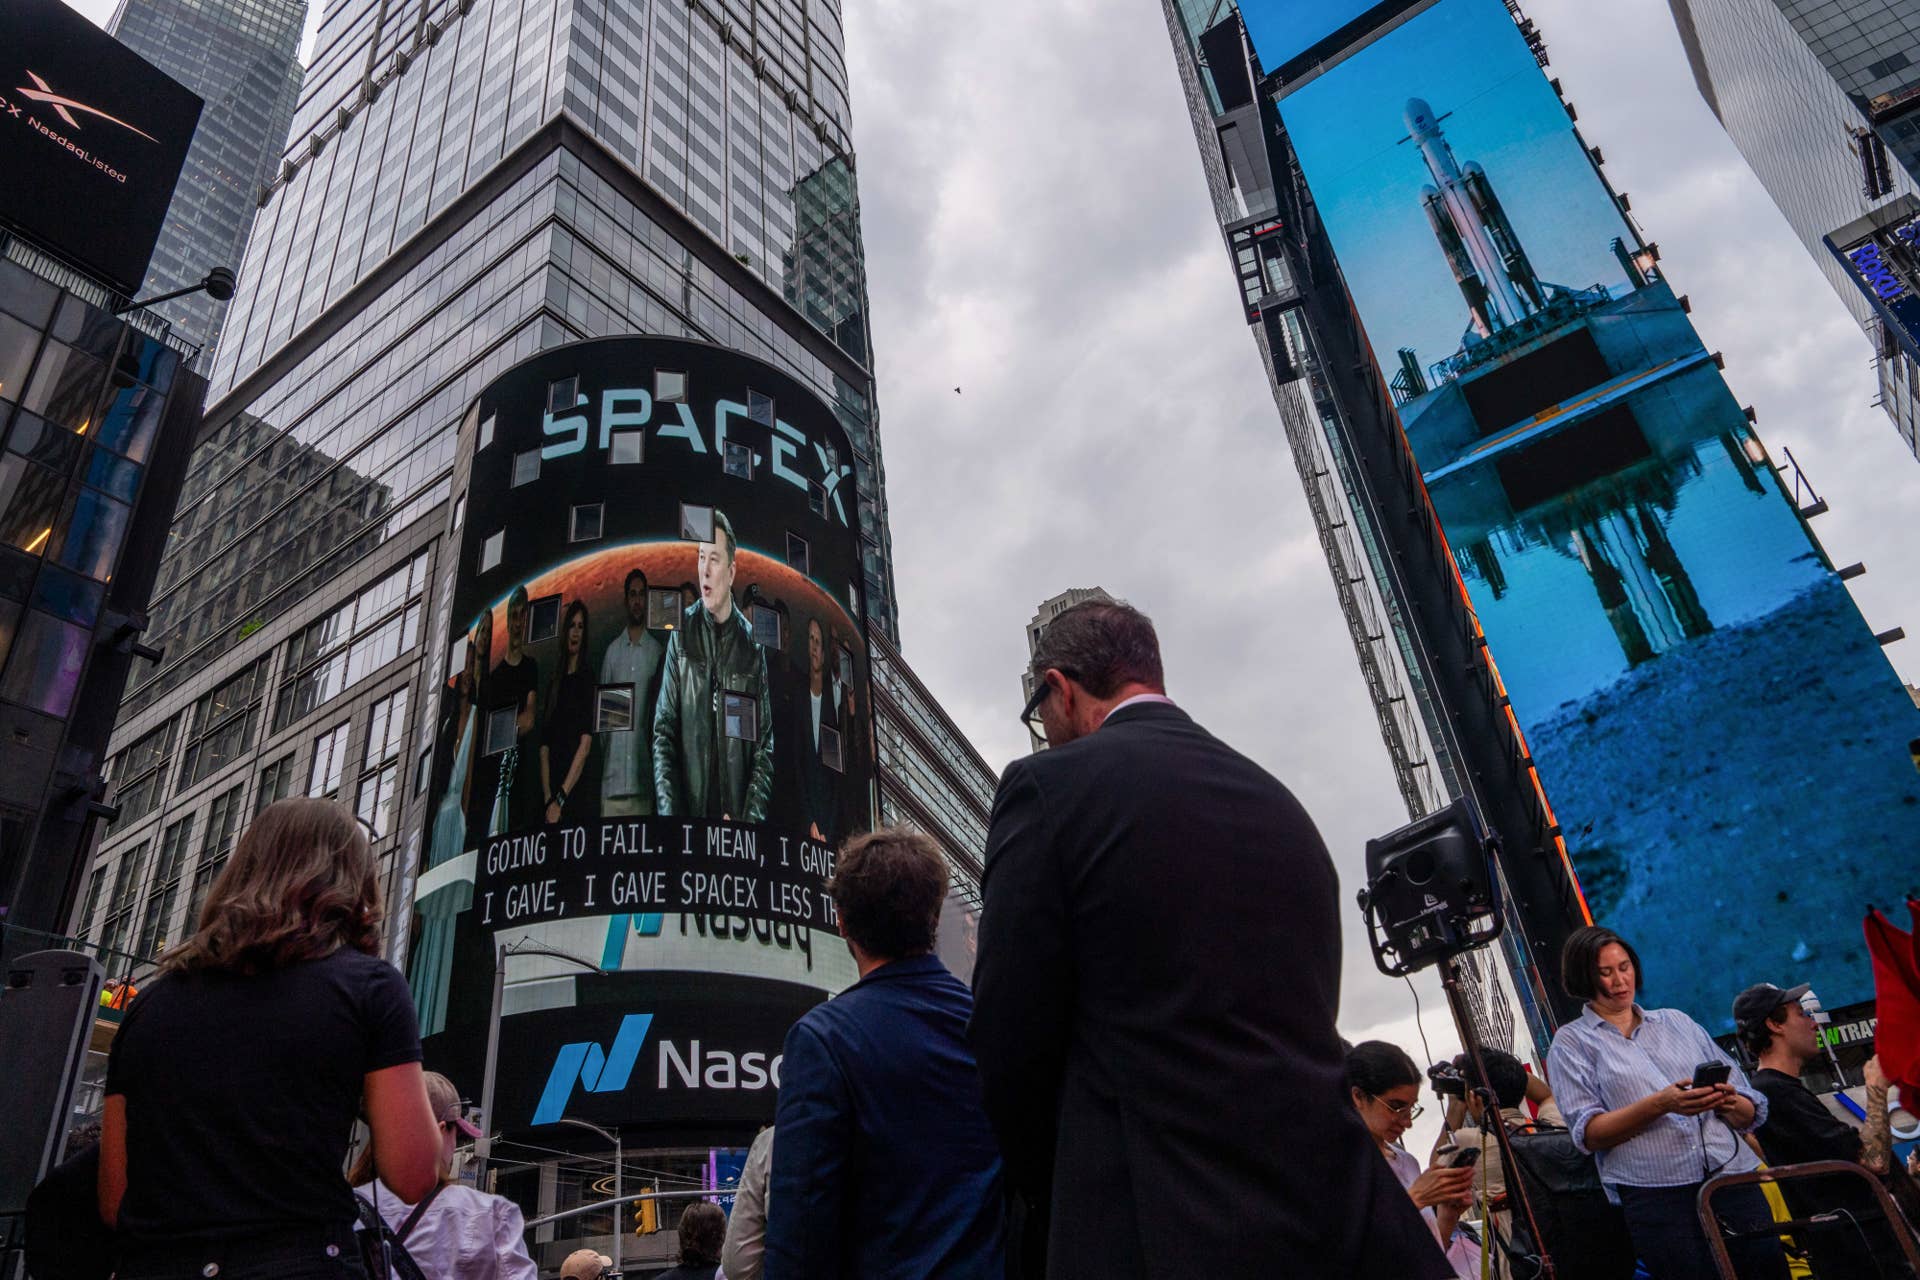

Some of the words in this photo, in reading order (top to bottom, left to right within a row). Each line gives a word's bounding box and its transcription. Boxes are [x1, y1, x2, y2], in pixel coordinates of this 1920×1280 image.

[28, 116, 128, 183] NasdaqListed
[541, 388, 852, 529] SPACEX
[487, 832, 547, 875] GOING
[560, 826, 586, 859] TO
[601, 823, 663, 855] FAIL.
[682, 824, 693, 854] I
[707, 826, 765, 868] MEAN,
[779, 836, 790, 866] I
[800, 841, 836, 879] GAVE
[482, 892, 494, 924] I
[505, 879, 565, 920] GAVE,
[584, 875, 597, 907] I
[611, 871, 666, 905] GAVE
[681, 871, 758, 909] SPACEX
[770, 881, 812, 919] LESS
